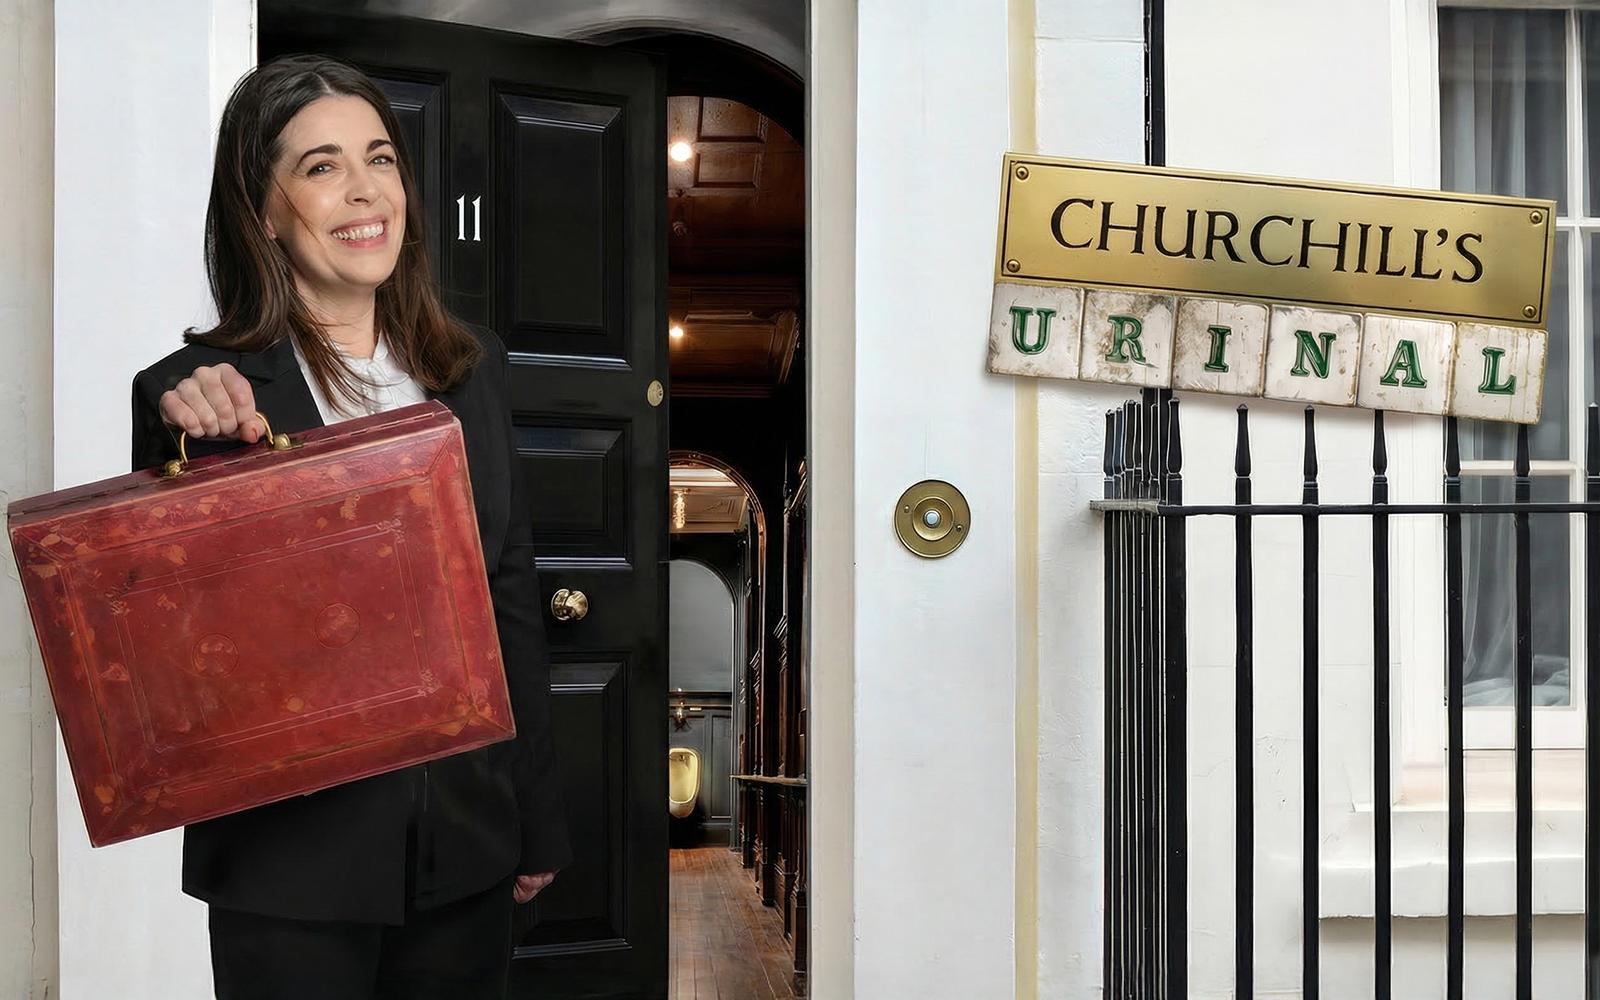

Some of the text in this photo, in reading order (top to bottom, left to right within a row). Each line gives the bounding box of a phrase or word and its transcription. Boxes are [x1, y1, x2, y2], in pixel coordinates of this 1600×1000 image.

[456, 193, 482, 242] 11
[1049, 198, 1484, 284] CHURCHILL'S
[1009, 305, 1518, 396] URINAL
